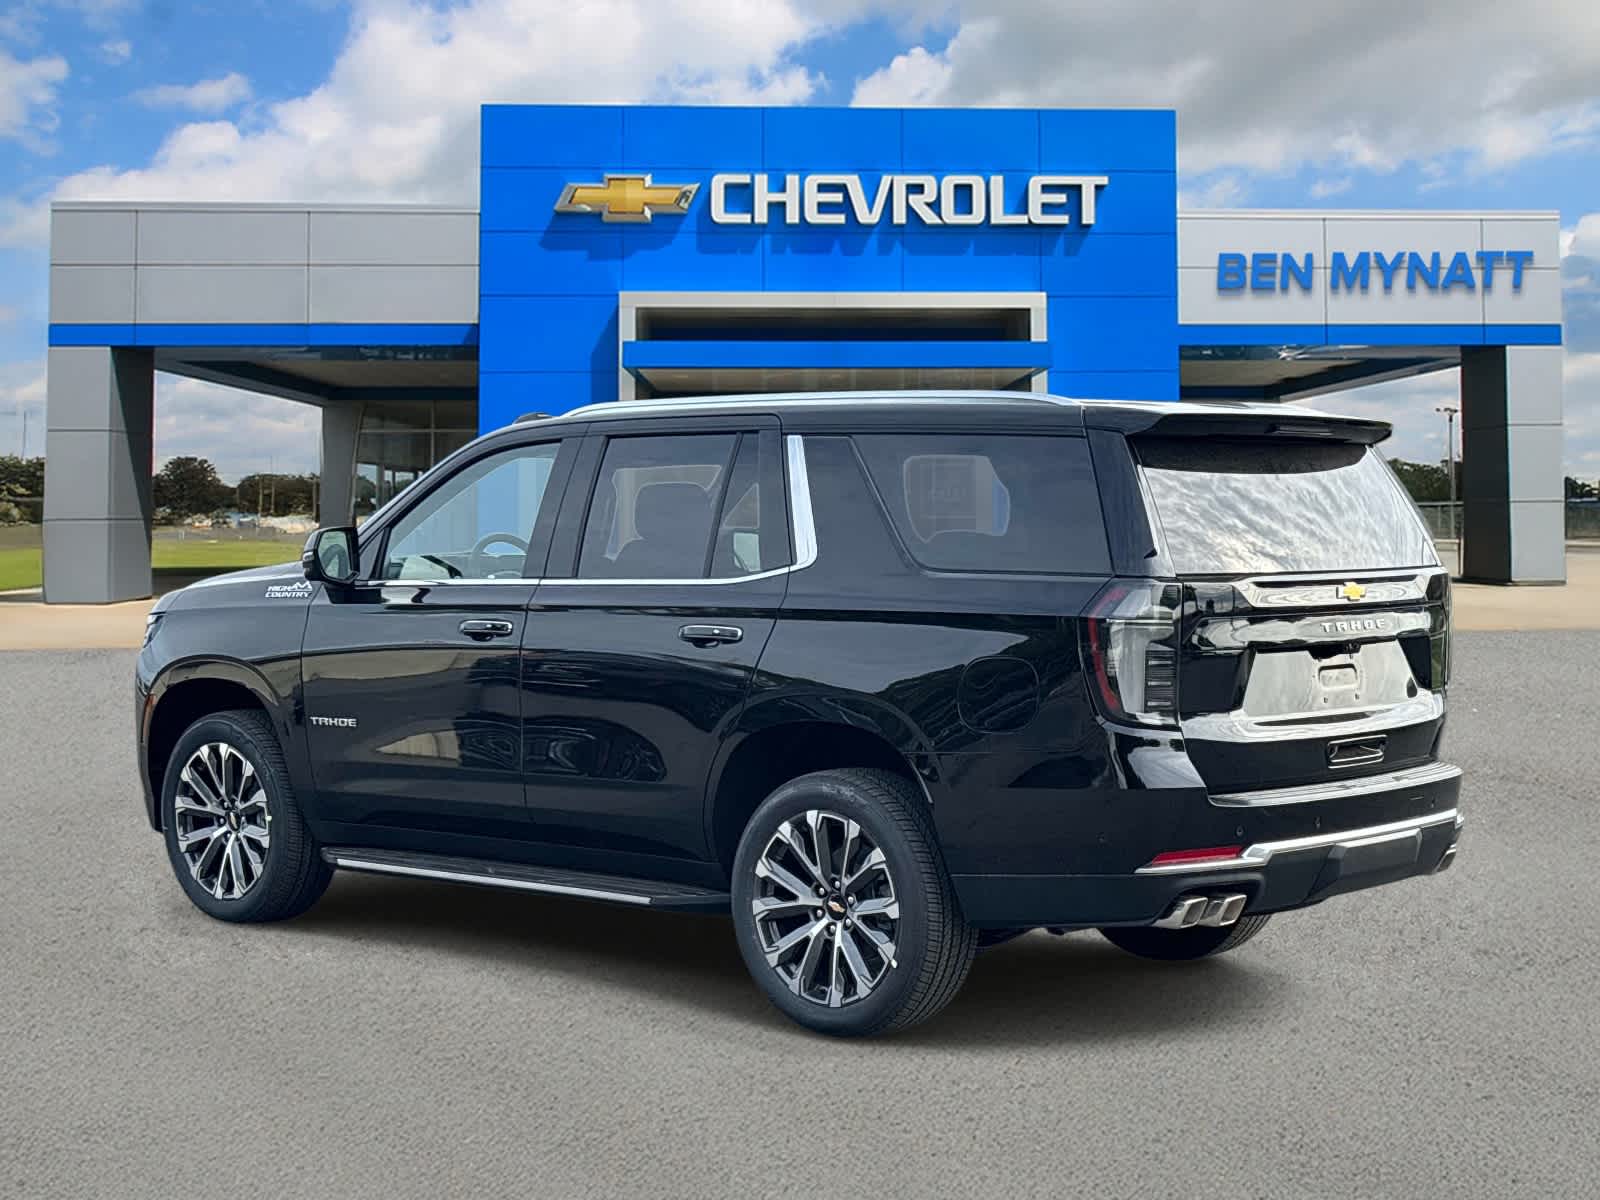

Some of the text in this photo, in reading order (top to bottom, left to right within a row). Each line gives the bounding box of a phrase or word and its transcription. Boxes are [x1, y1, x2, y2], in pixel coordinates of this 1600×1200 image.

[710, 174, 1109, 225] CHEVROLET
[1217, 250, 1534, 291] BEN MYNATT
[1321, 618, 1385, 633] TAHOE
[310, 716, 357, 727] TAHOE
